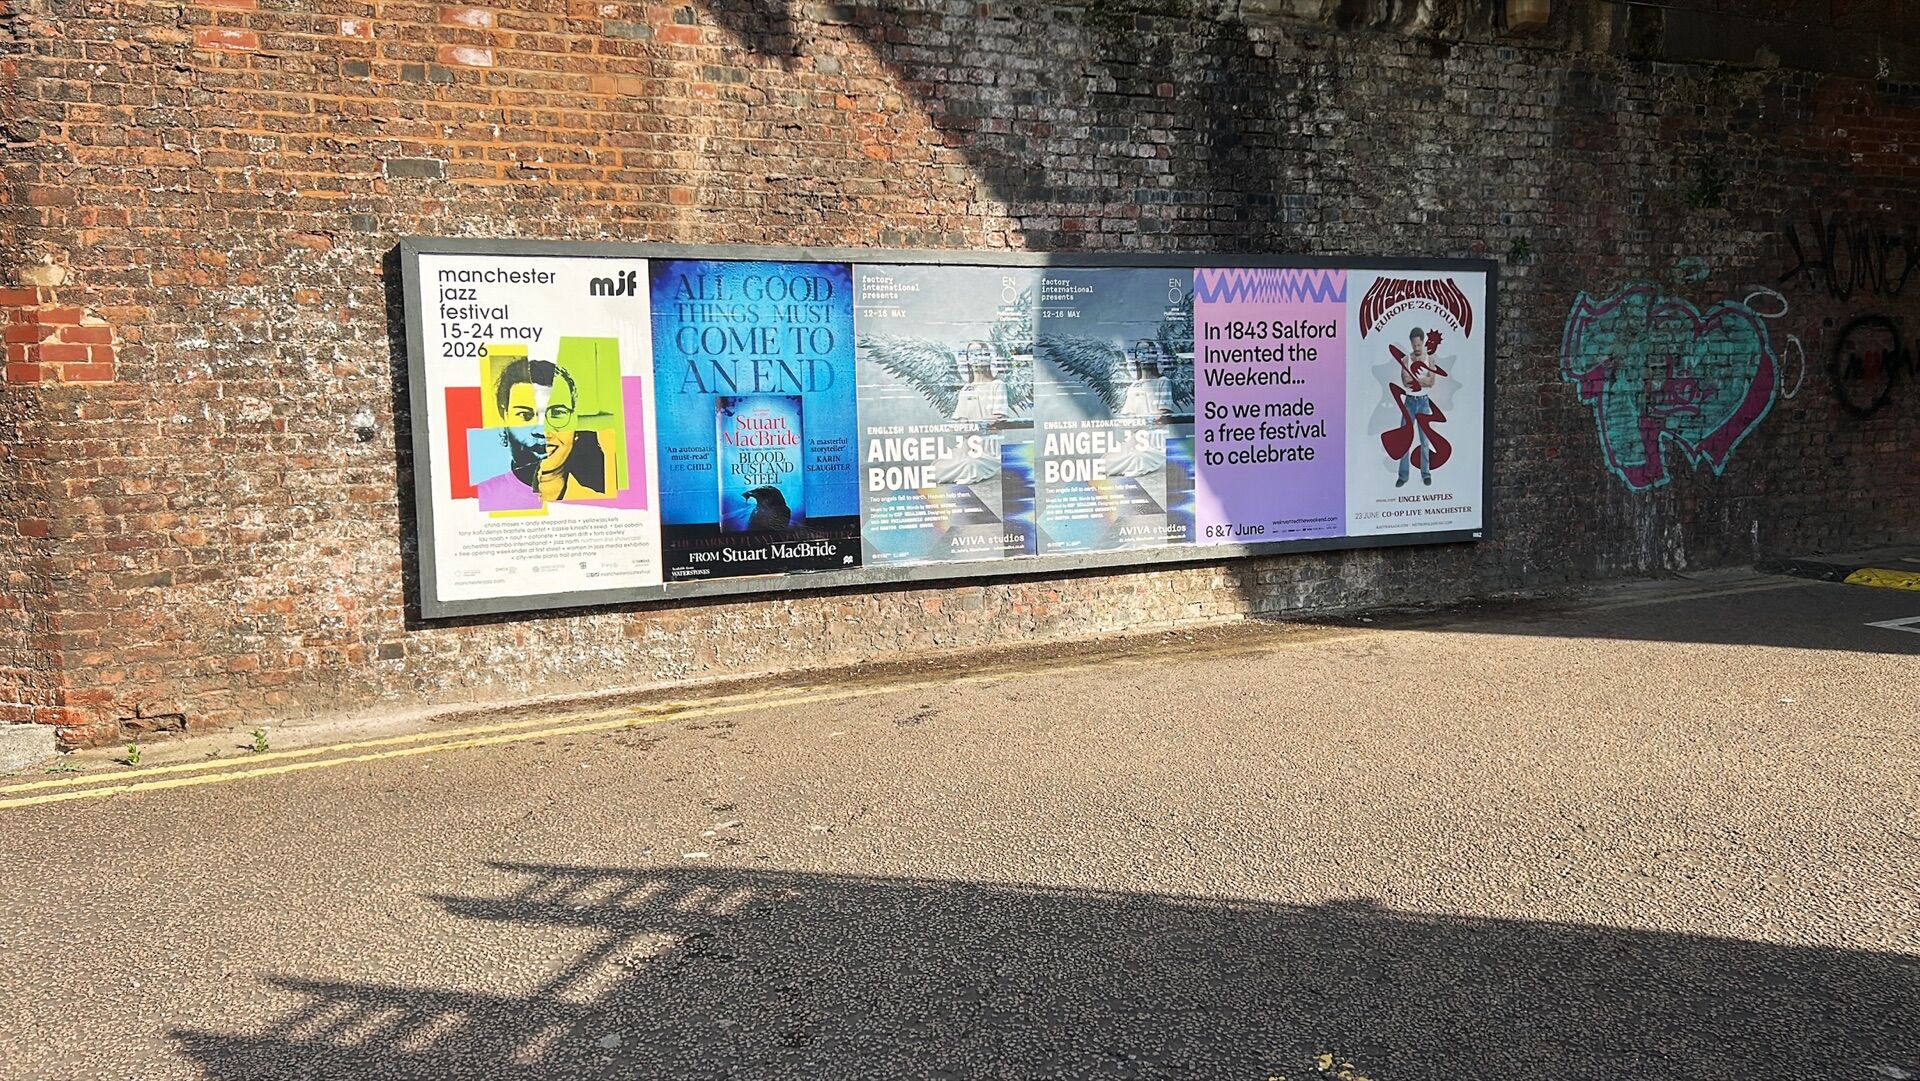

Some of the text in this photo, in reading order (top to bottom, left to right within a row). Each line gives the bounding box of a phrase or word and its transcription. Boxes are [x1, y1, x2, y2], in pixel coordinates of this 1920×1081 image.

[439, 268, 555, 284] manchester
[590, 270, 637, 296] mjf
[862, 275, 894, 285] factory
[1042, 278, 1070, 286] factory
[440, 285, 477, 302] jazz
[674, 274, 833, 301] ALL GOOD
[862, 284, 920, 292] international
[862, 292, 898, 300] presents
[1042, 294, 1074, 302] presents
[441, 304, 508, 319] festival
[674, 304, 834, 324] THINGS MUST
[864, 310, 906, 318] 12-16 MAY
[1375, 300, 1458, 332] EUROPE '26 TOUR
[441, 323, 543, 342] 15-24 may
[1204, 320, 1336, 340] In 1843 Salford
[676, 326, 834, 356] COME TO
[443, 342, 488, 358] 2026
[1204, 343, 1318, 363] Invented the
[678, 360, 835, 394] AN END
[1204, 366, 1305, 386] Weekend...
[1205, 398, 1314, 419] So we made
[736, 414, 786, 430] Stuart
[867, 424, 979, 434] ENGLISH NATIONAL OPERA
[1044, 418, 1146, 429] ENGLISH NATIONAL OPERA
[724, 430, 801, 447] MacBride
[1204, 419, 1326, 442] a free festival
[867, 435, 983, 462] ANGEL'S
[1043, 430, 1150, 456] ANGEL'S
[672, 453, 710, 461] must-read'
[739, 452, 786, 464] BLOOD,
[1205, 444, 1315, 466] to celebrate
[731, 462, 794, 474] RUST AND
[807, 464, 850, 472] SLAUGHTER
[1045, 458, 1106, 483] BONE
[744, 473, 782, 485] STEEL
[868, 466, 937, 492] BONE
[1398, 495, 1421, 503] UNCLE
[1422, 493, 1453, 502] WAFFLES
[1355, 512, 1362, 520] 23
[1382, 510, 1404, 518] CO-OP
[1424, 506, 1472, 515] MANCHESTER
[1119, 524, 1186, 535] AVIVA studios
[1235, 524, 1265, 536] June
[951, 534, 1024, 546] AVIVA studios
[689, 542, 837, 563] FROM Stuart MacBride
[672, 569, 710, 577] WATERSTONES
